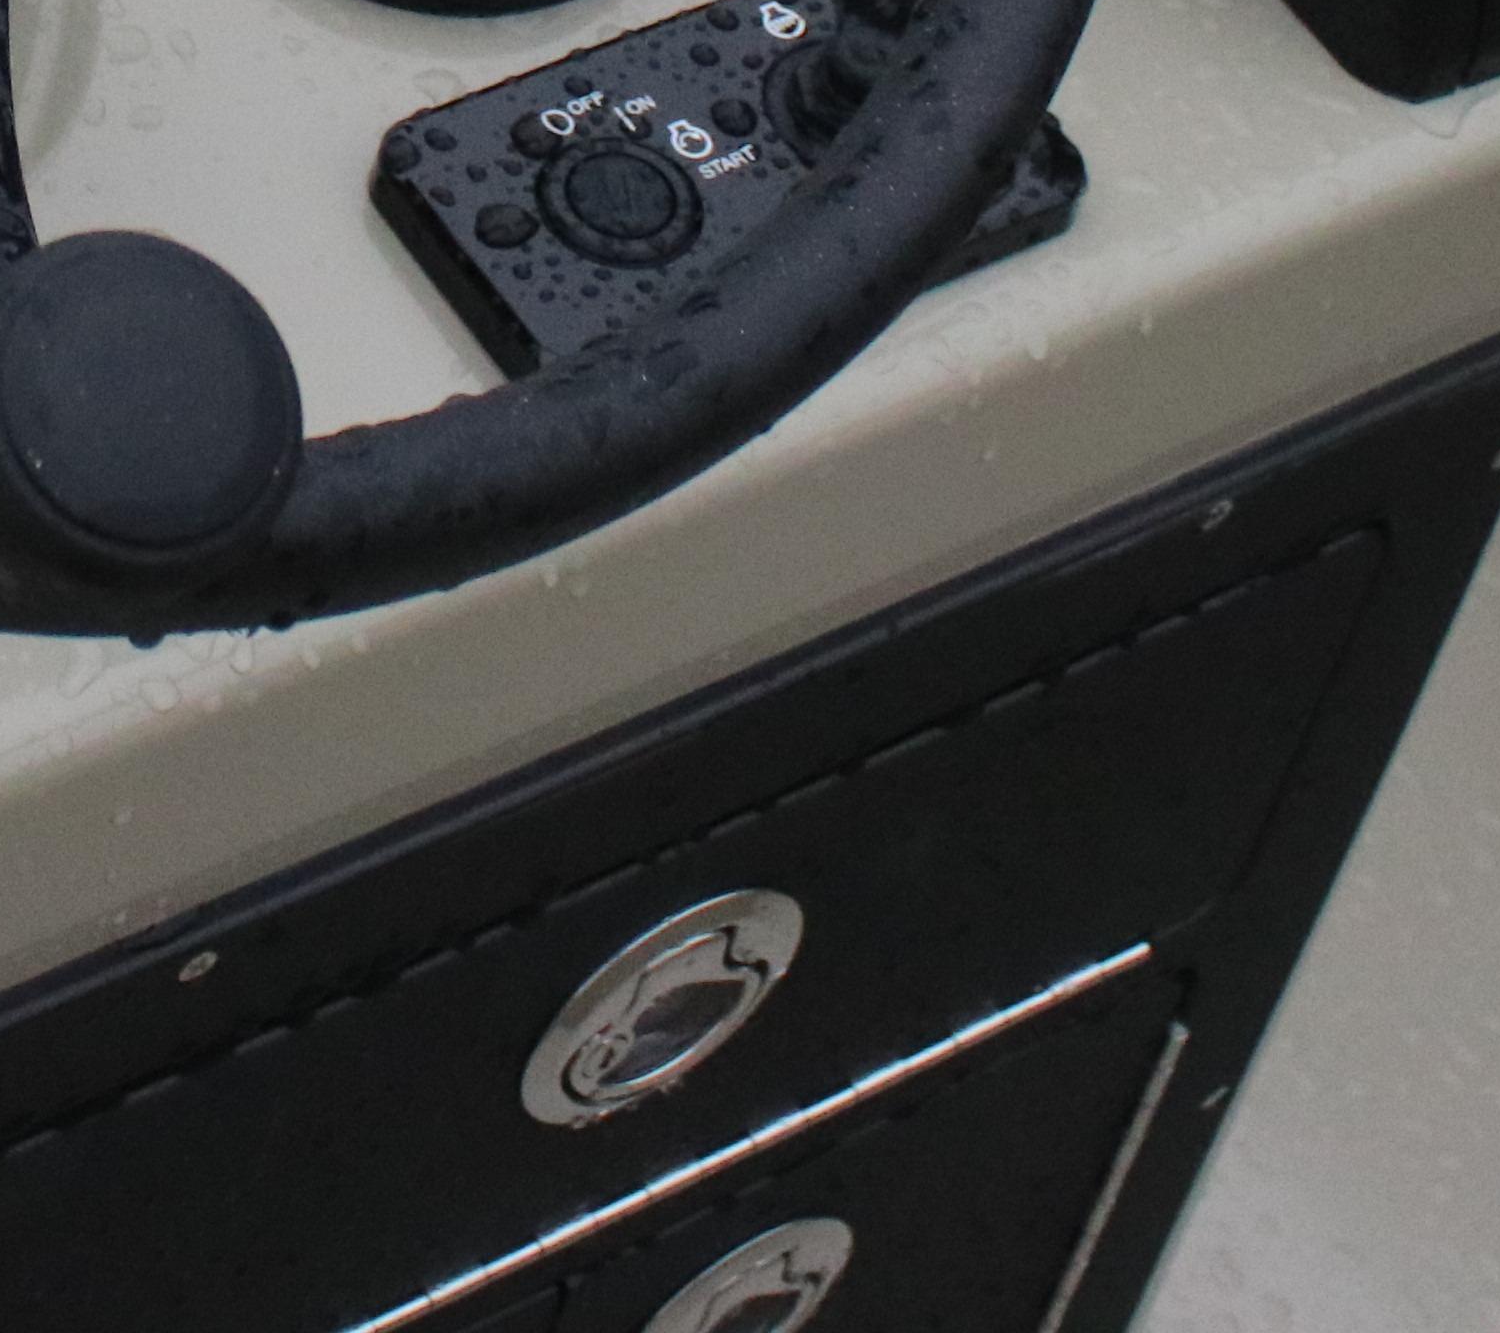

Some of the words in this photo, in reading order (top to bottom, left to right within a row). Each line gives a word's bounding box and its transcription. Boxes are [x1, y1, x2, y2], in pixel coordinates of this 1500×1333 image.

[566, 91, 604, 116] OFF
[625, 95, 656, 115] ON
[699, 143, 757, 179] START
